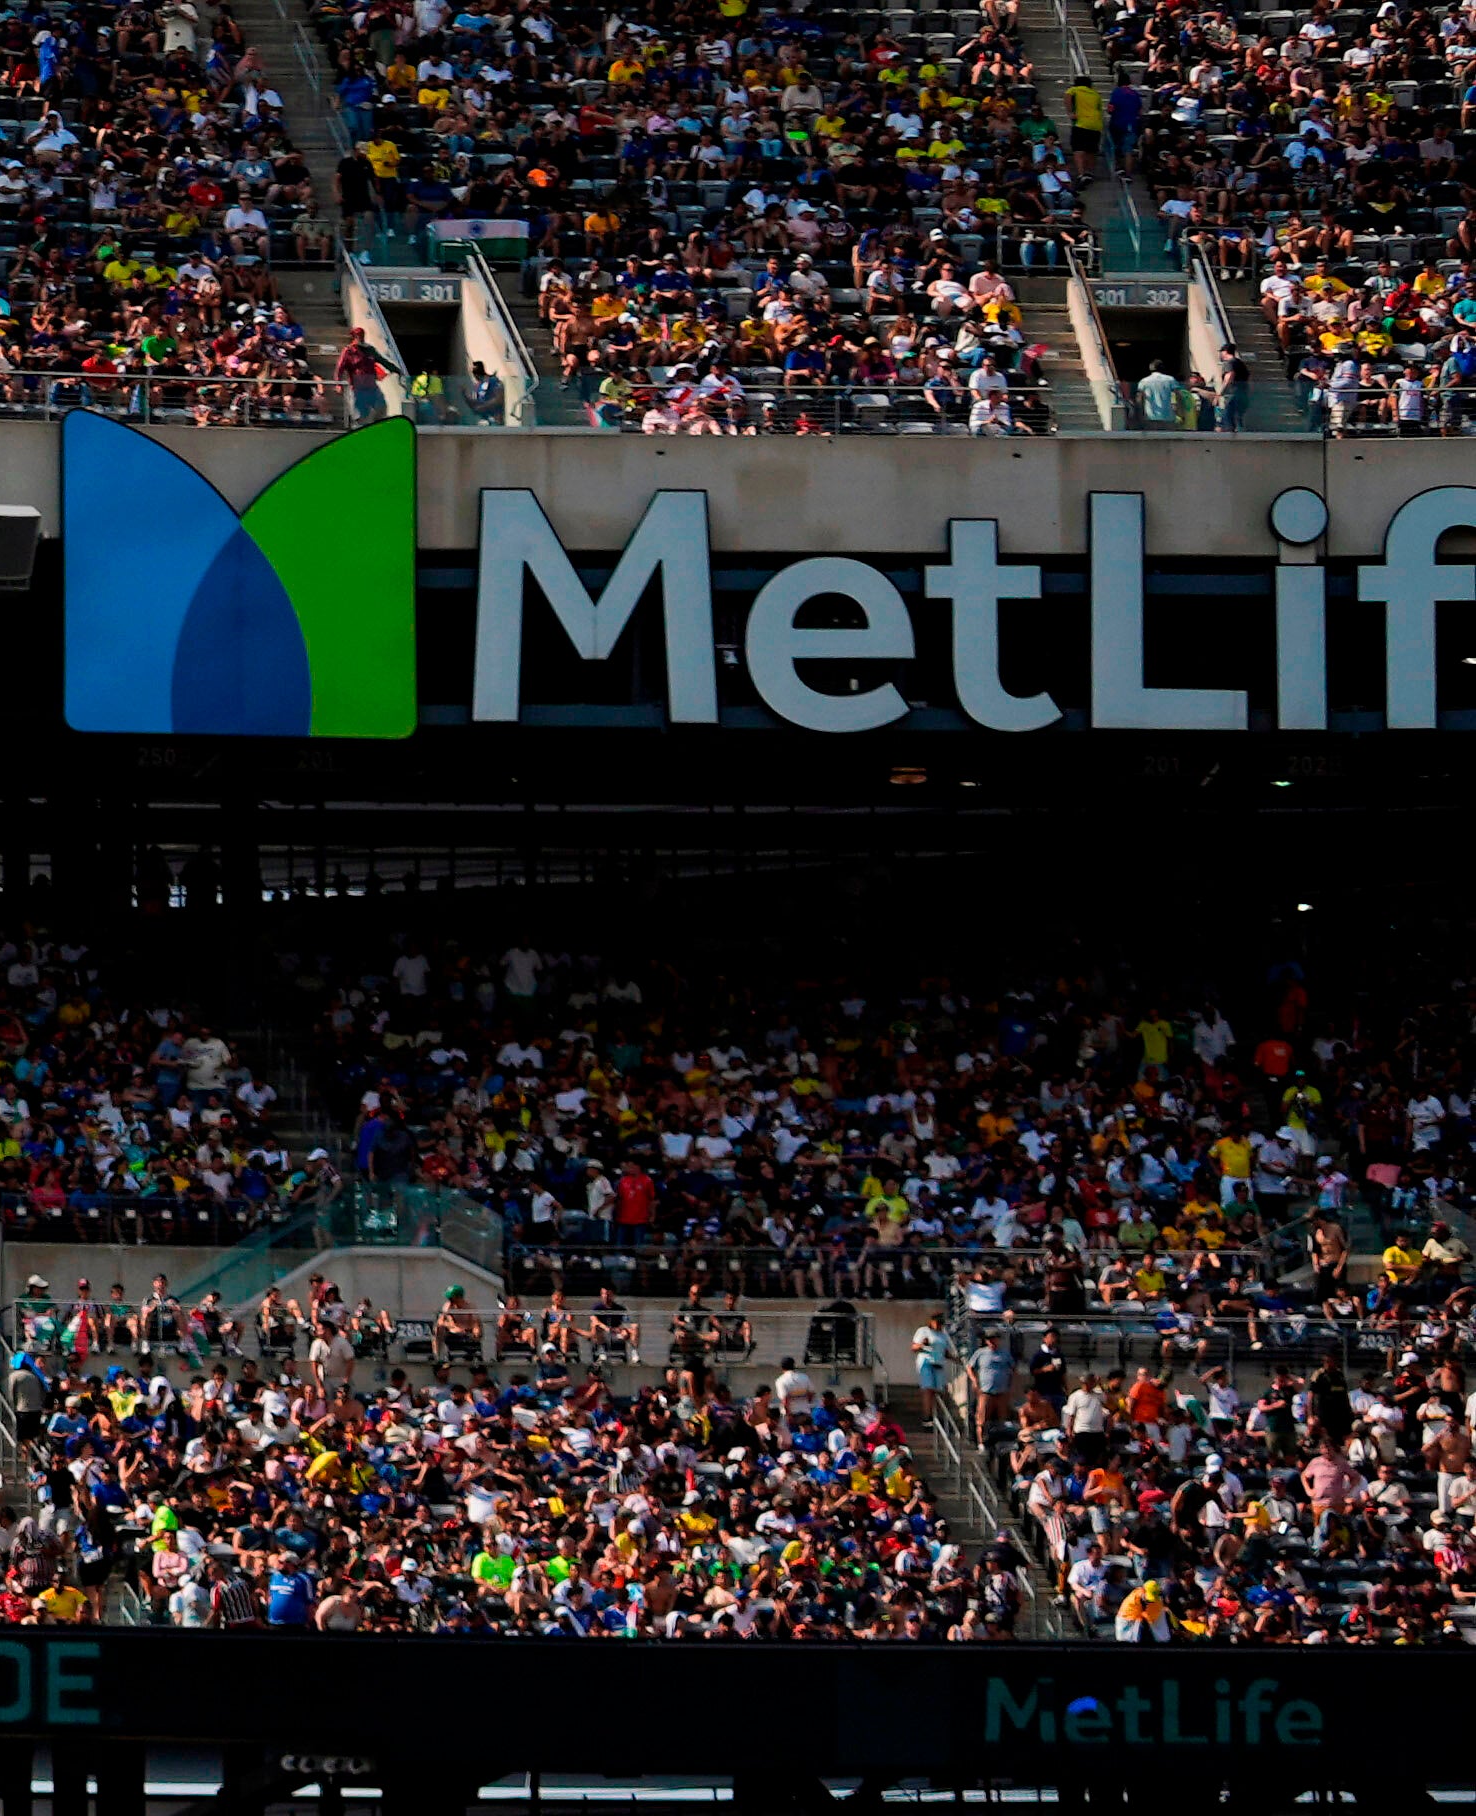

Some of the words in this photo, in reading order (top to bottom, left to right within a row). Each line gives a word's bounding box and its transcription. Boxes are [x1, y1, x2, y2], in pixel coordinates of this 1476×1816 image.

[421, 284, 454, 301] 301
[1095, 289, 1127, 306] 301
[1146, 289, 1180, 305] 302
[472, 484, 1476, 734] MetLif
[984, 1676, 1324, 1746] MetLife
